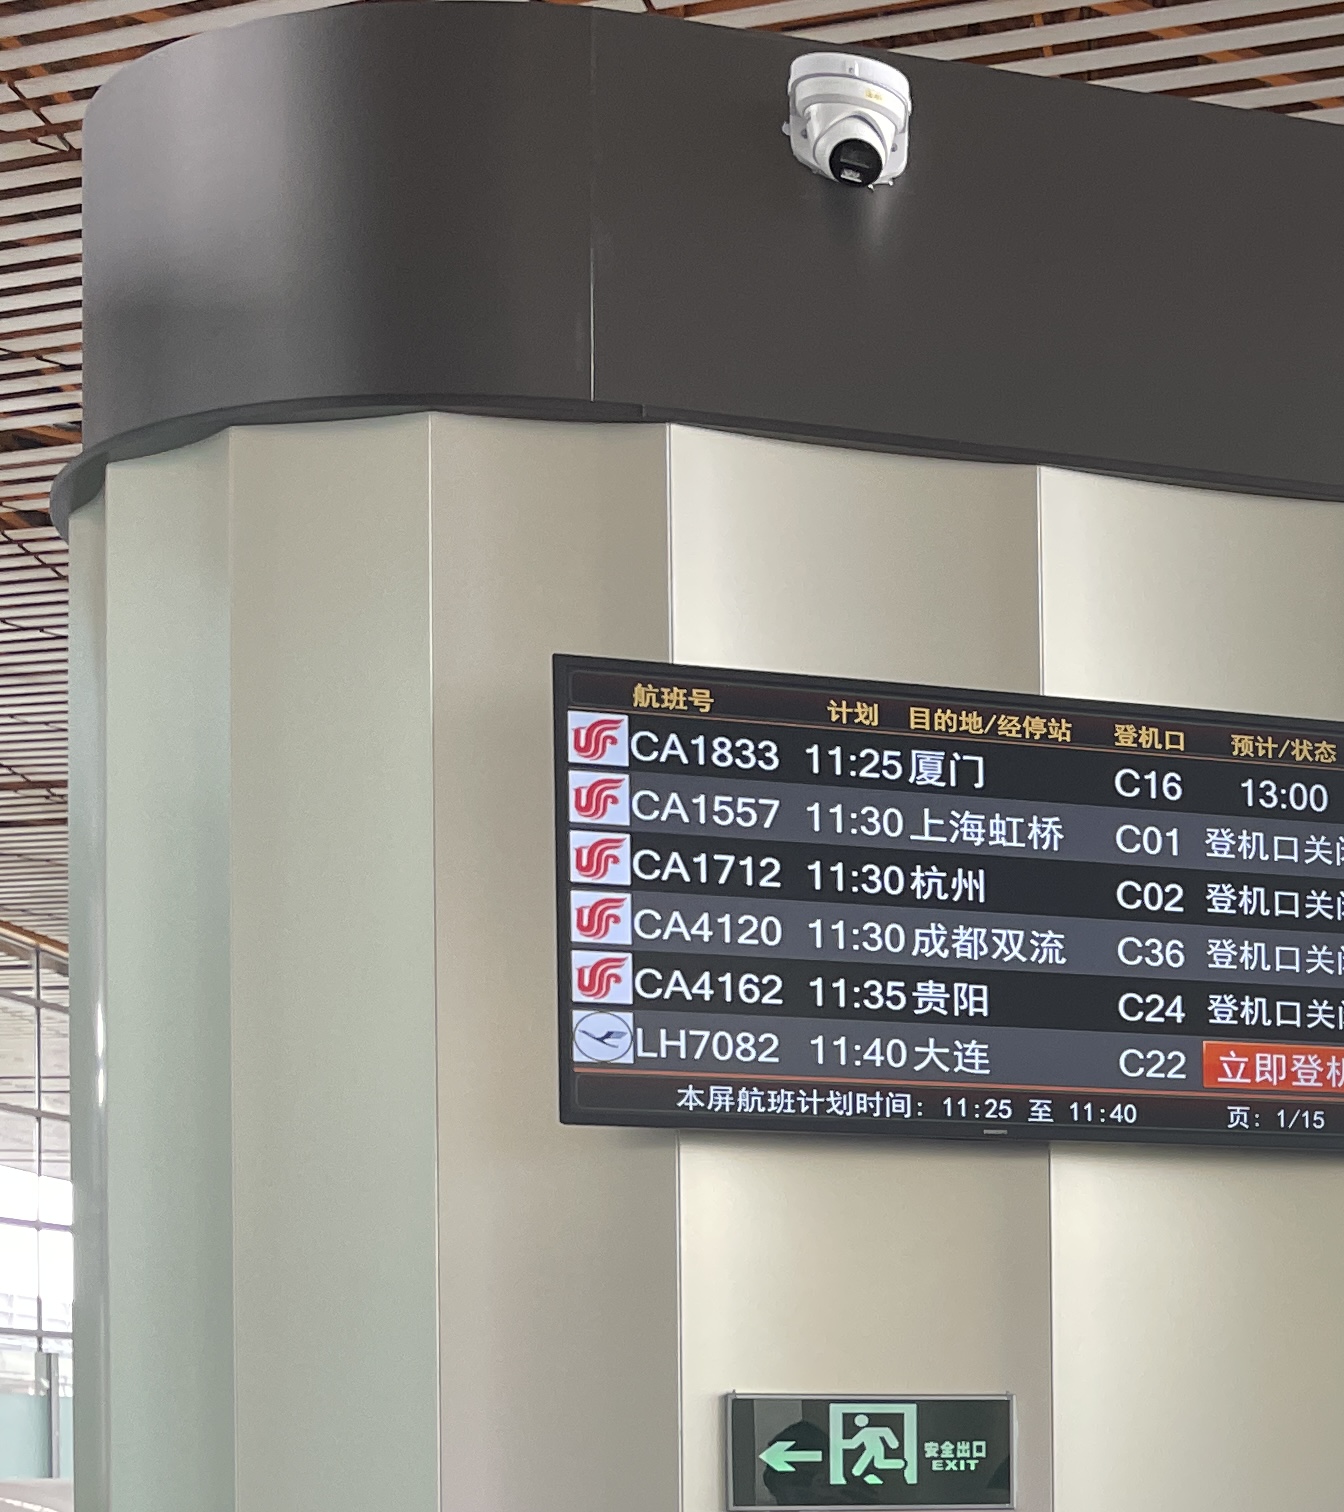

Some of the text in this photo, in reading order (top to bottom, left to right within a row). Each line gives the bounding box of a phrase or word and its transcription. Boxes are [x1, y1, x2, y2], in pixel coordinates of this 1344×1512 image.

[632, 682, 1337, 763] 航班号 计划 目的地/经停站 登机口 预计/状态
[630, 730, 1328, 812] CA1833 11:25 厦门 C16 13:00
[631, 789, 780, 829] CA1557
[806, 802, 904, 838] 11:30
[909, 807, 1065, 852] 上海虹桥
[1115, 824, 1178, 856] C01
[632, 849, 782, 888] CA1712
[807, 860, 905, 895] 11:30
[910, 864, 985, 903] 杭州
[1116, 880, 1184, 913] C02
[633, 908, 782, 946] CA4120
[808, 918, 906, 953] 11:30
[911, 922, 1067, 965] 成都双流
[1117, 936, 1185, 968] C36
[634, 968, 784, 1005] CA4162
[809, 976, 907, 1011] 11:35
[911, 979, 988, 1017] 贵阳
[1118, 992, 1186, 1024] C24
[636, 1027, 780, 1063] LH7082
[810, 1035, 907, 1068] 11:40
[913, 1037, 991, 1075] 大连
[1119, 1048, 1187, 1079] C22
[943, 1096, 1013, 1119] 11:25
[1027, 1099, 1054, 1123] 至
[1069, 1101, 1137, 1124] 11:40
[1277, 1109, 1325, 1129] 1/15
[924, 1440, 986, 1459] 安全出口
[932, 1459, 979, 1471] EXIT
